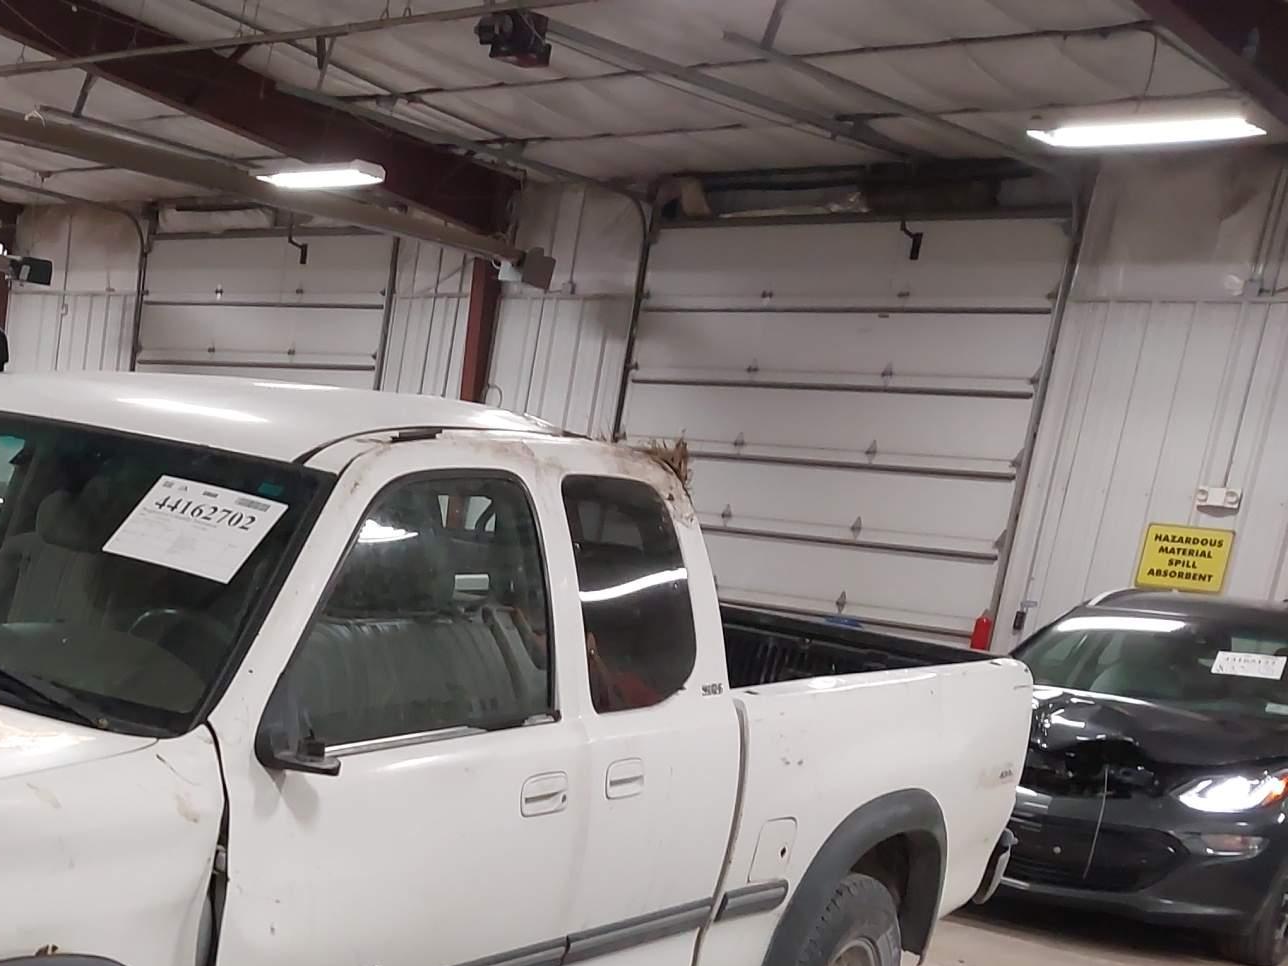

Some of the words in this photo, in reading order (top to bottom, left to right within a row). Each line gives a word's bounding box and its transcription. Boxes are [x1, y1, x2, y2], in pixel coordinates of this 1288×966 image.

[155, 496, 256, 530] 44162702
[1154, 533, 1224, 547] HAZARDOUS
[1158, 545, 1213, 559] MATERIAL
[1167, 558, 1197, 569] SPILL
[1147, 569, 1213, 582] ABSORBENT
